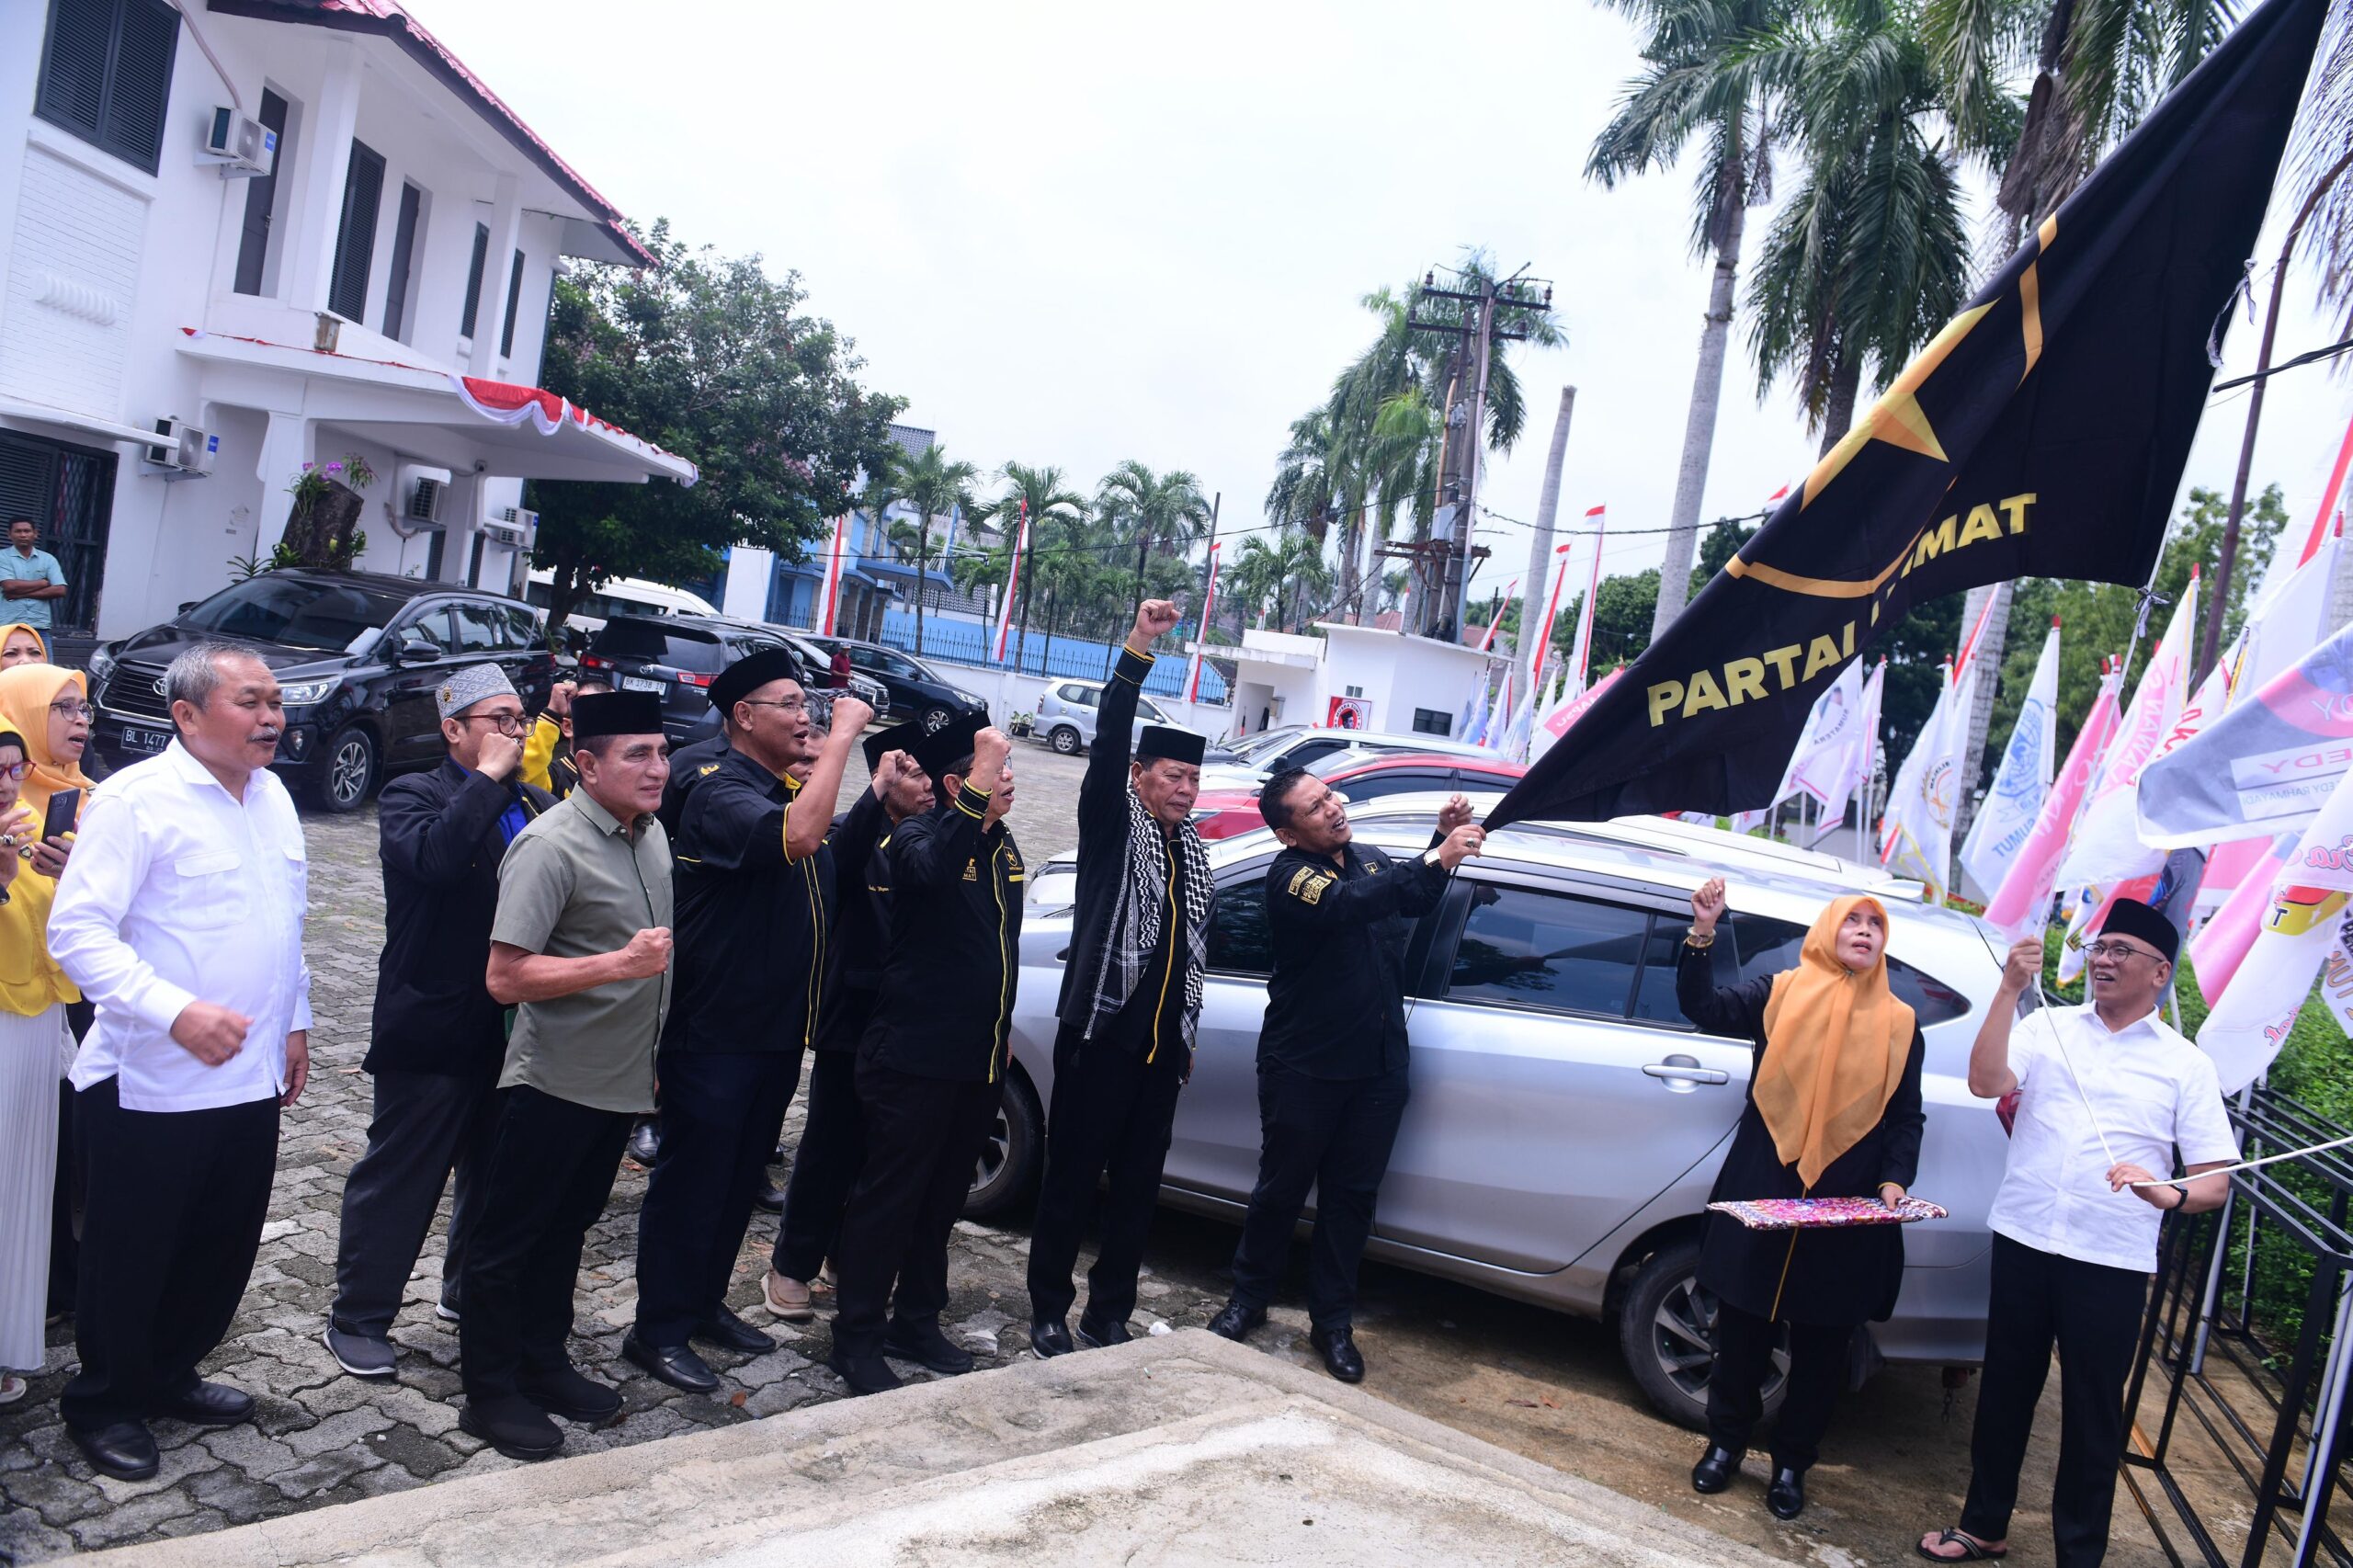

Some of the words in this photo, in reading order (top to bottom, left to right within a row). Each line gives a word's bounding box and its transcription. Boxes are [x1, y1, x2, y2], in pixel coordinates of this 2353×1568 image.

[1647, 620, 1856, 727] PARTAI
[1870, 493, 2037, 628] MAT
[126, 731, 138, 743] BL
[144, 733, 166, 746] 1477
